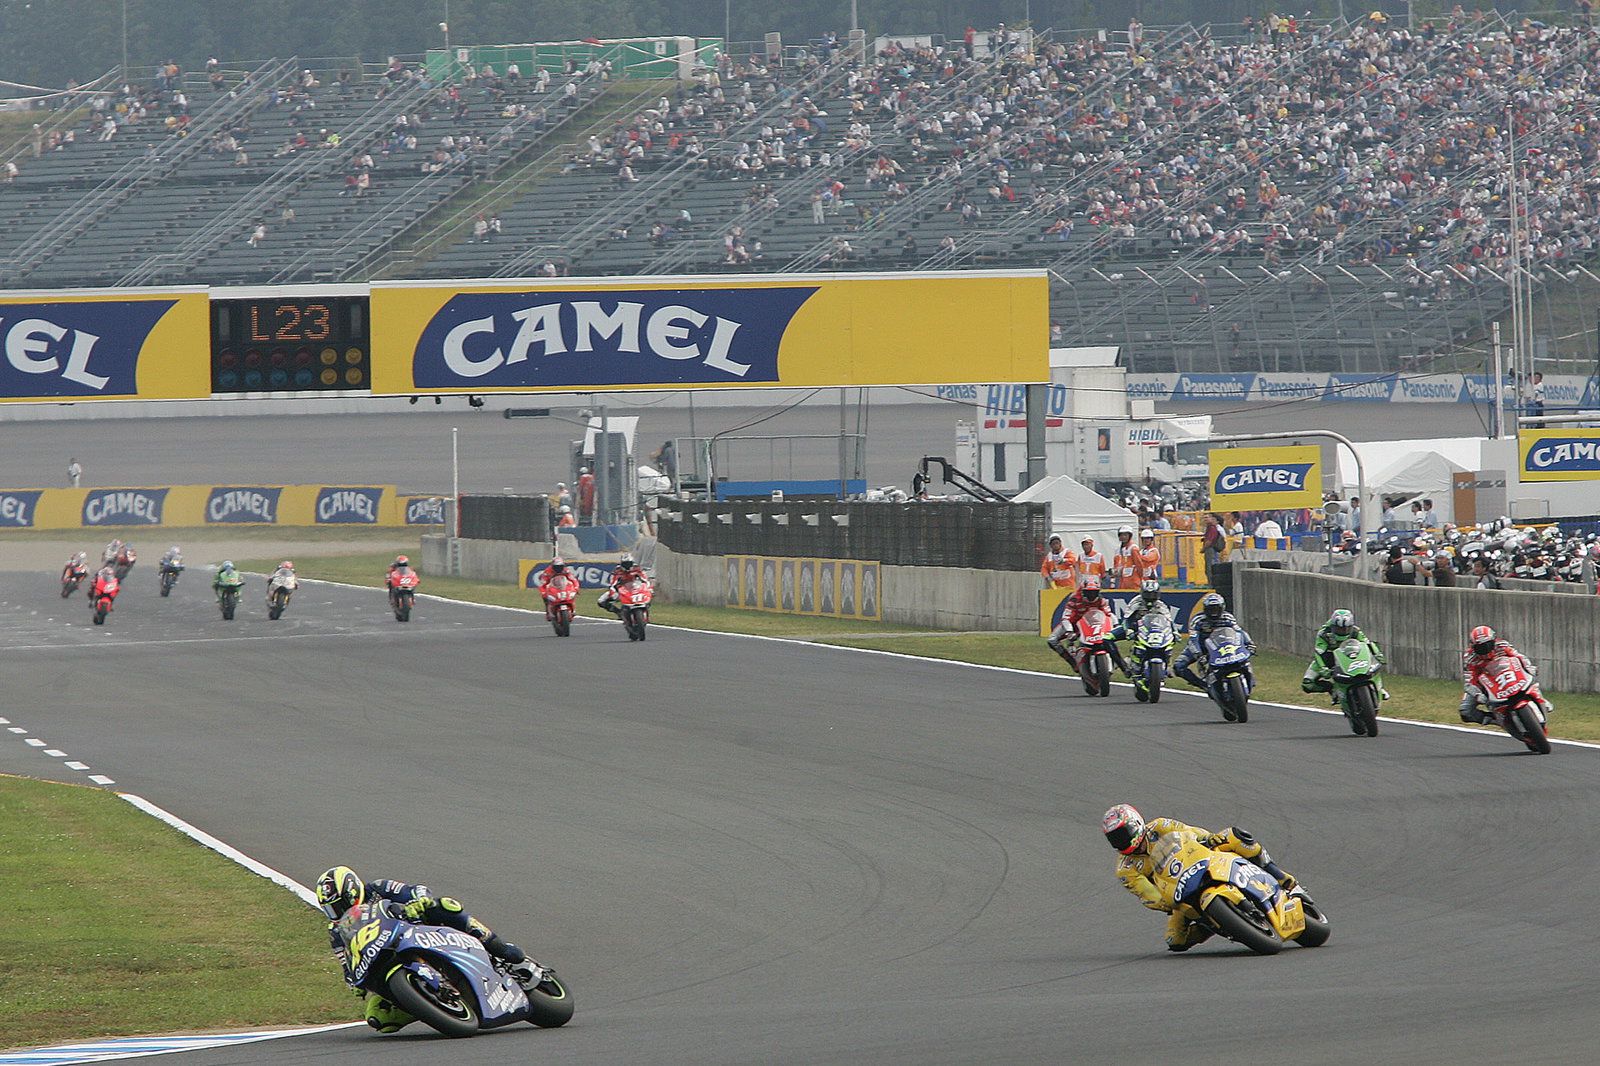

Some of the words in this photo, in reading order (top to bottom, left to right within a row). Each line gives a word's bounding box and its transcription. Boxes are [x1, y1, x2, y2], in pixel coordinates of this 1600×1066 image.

[251, 304, 331, 341] L23
[443, 300, 752, 377] CAMEL
[1182, 377, 1244, 398] Panasonic
[1259, 377, 1317, 398] Panasonic
[1402, 378, 1456, 399] Panasonic
[1220, 469, 1302, 490] CAMEL
[85, 492, 158, 523] CAMEL
[209, 491, 272, 521] CAMEL
[318, 491, 375, 521] CAMEL
[1495, 670, 1518, 690] 33
[1168, 857, 1184, 879] 6
[1174, 862, 1206, 902] CAMEL
